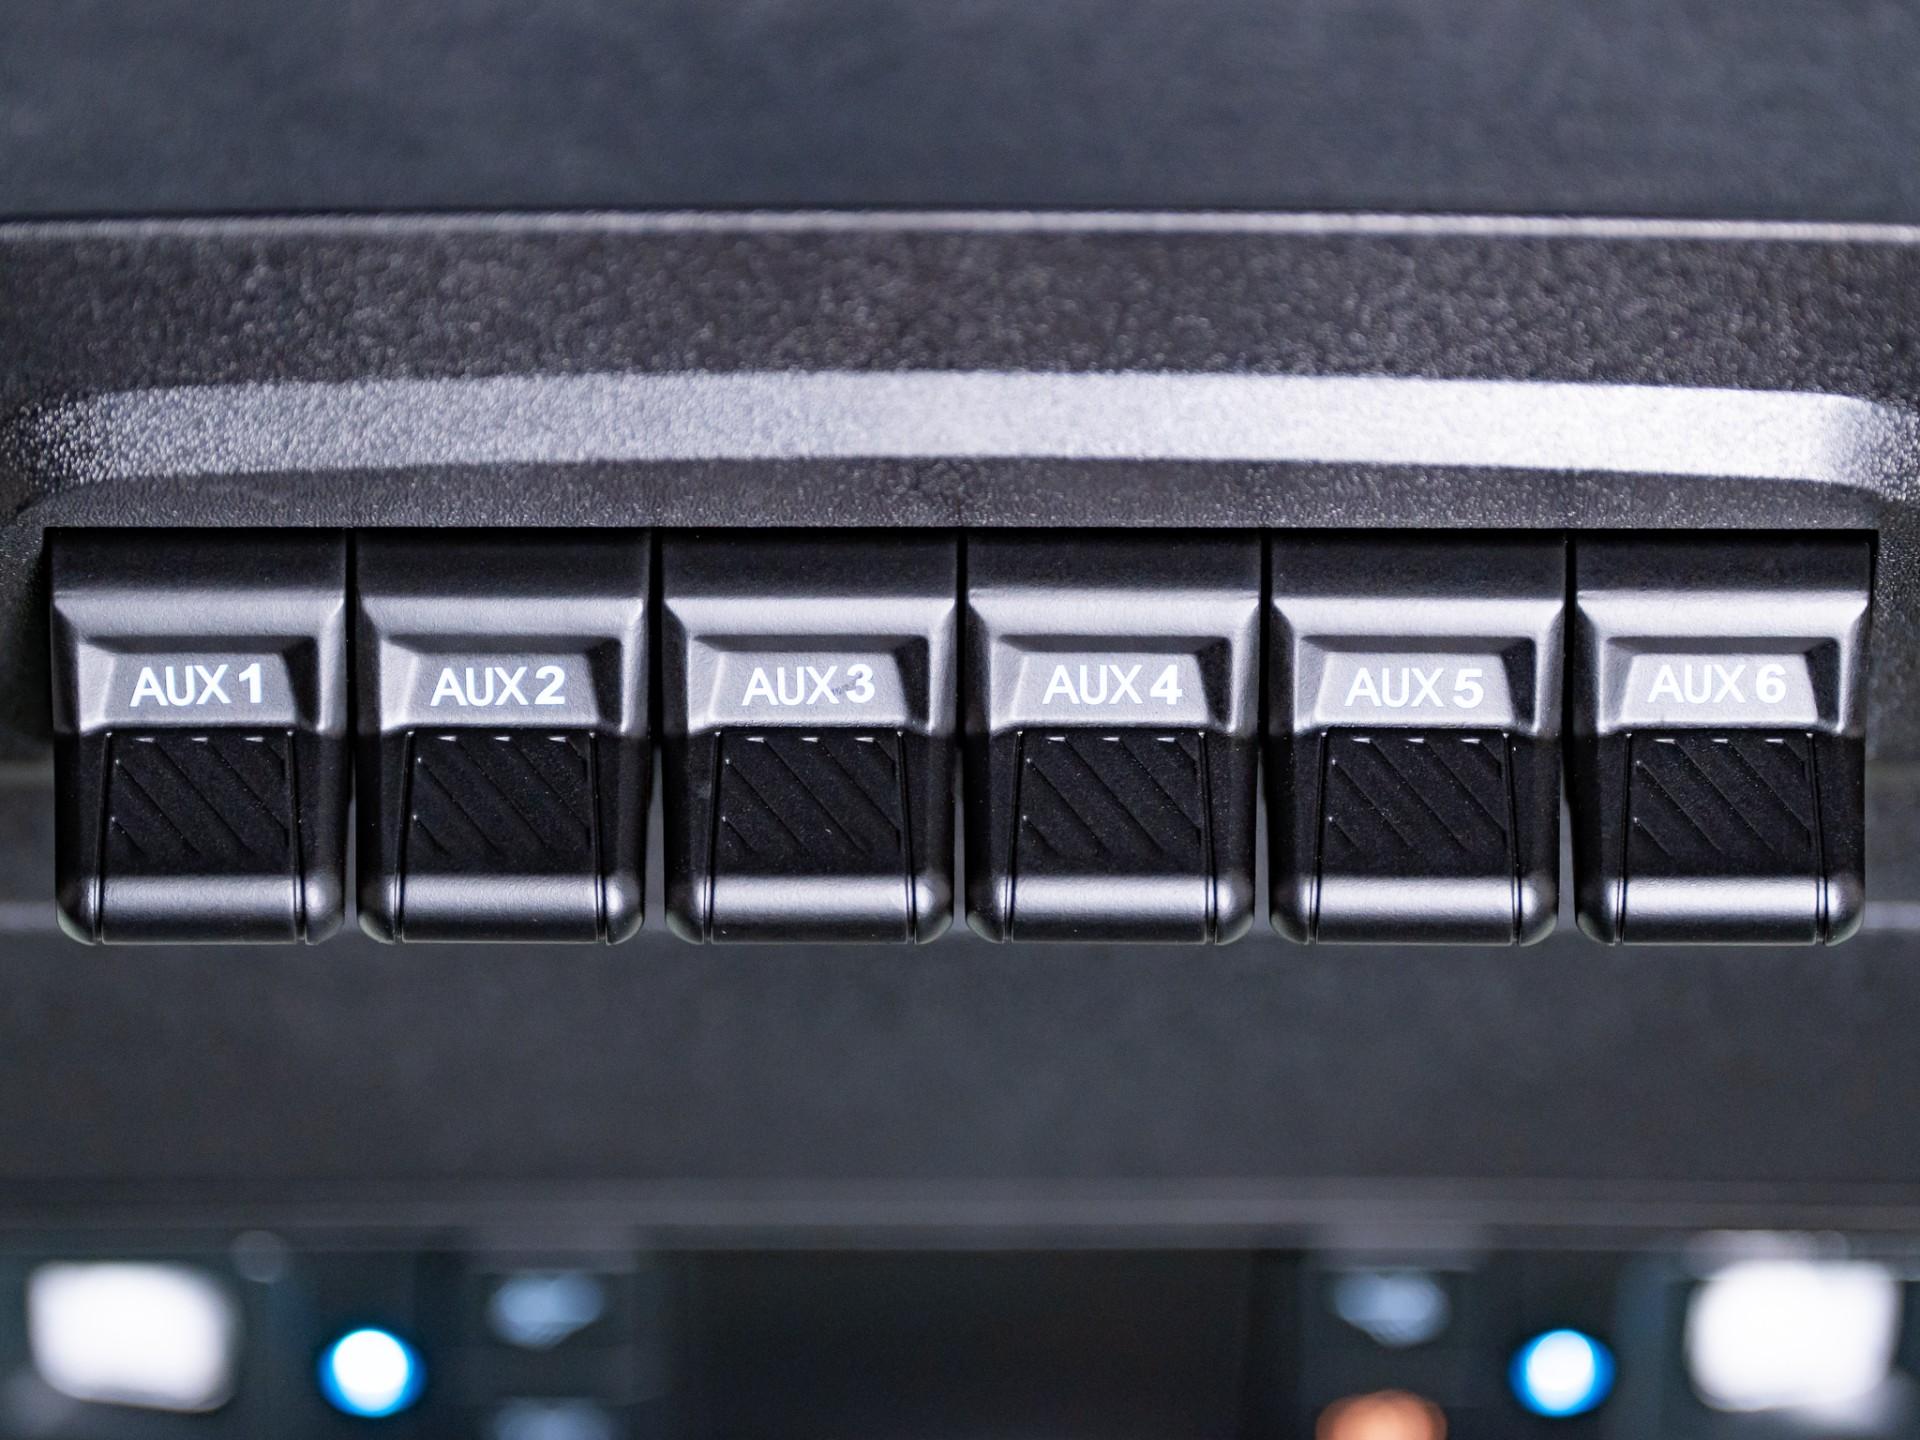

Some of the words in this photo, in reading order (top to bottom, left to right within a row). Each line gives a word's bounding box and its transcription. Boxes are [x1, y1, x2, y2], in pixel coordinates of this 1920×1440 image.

[130, 664, 229, 707] AUX
[238, 664, 262, 704] 1
[430, 666, 529, 707] AUX
[534, 666, 565, 705] 2
[742, 664, 838, 706] AUX
[844, 664, 875, 704] 3
[1042, 664, 1142, 706] AUX
[1149, 664, 1183, 705] 4
[1343, 666, 1444, 708] AUX
[1452, 669, 1484, 708] 5
[1646, 664, 1746, 705] AUX
[1755, 664, 1786, 703] 6
